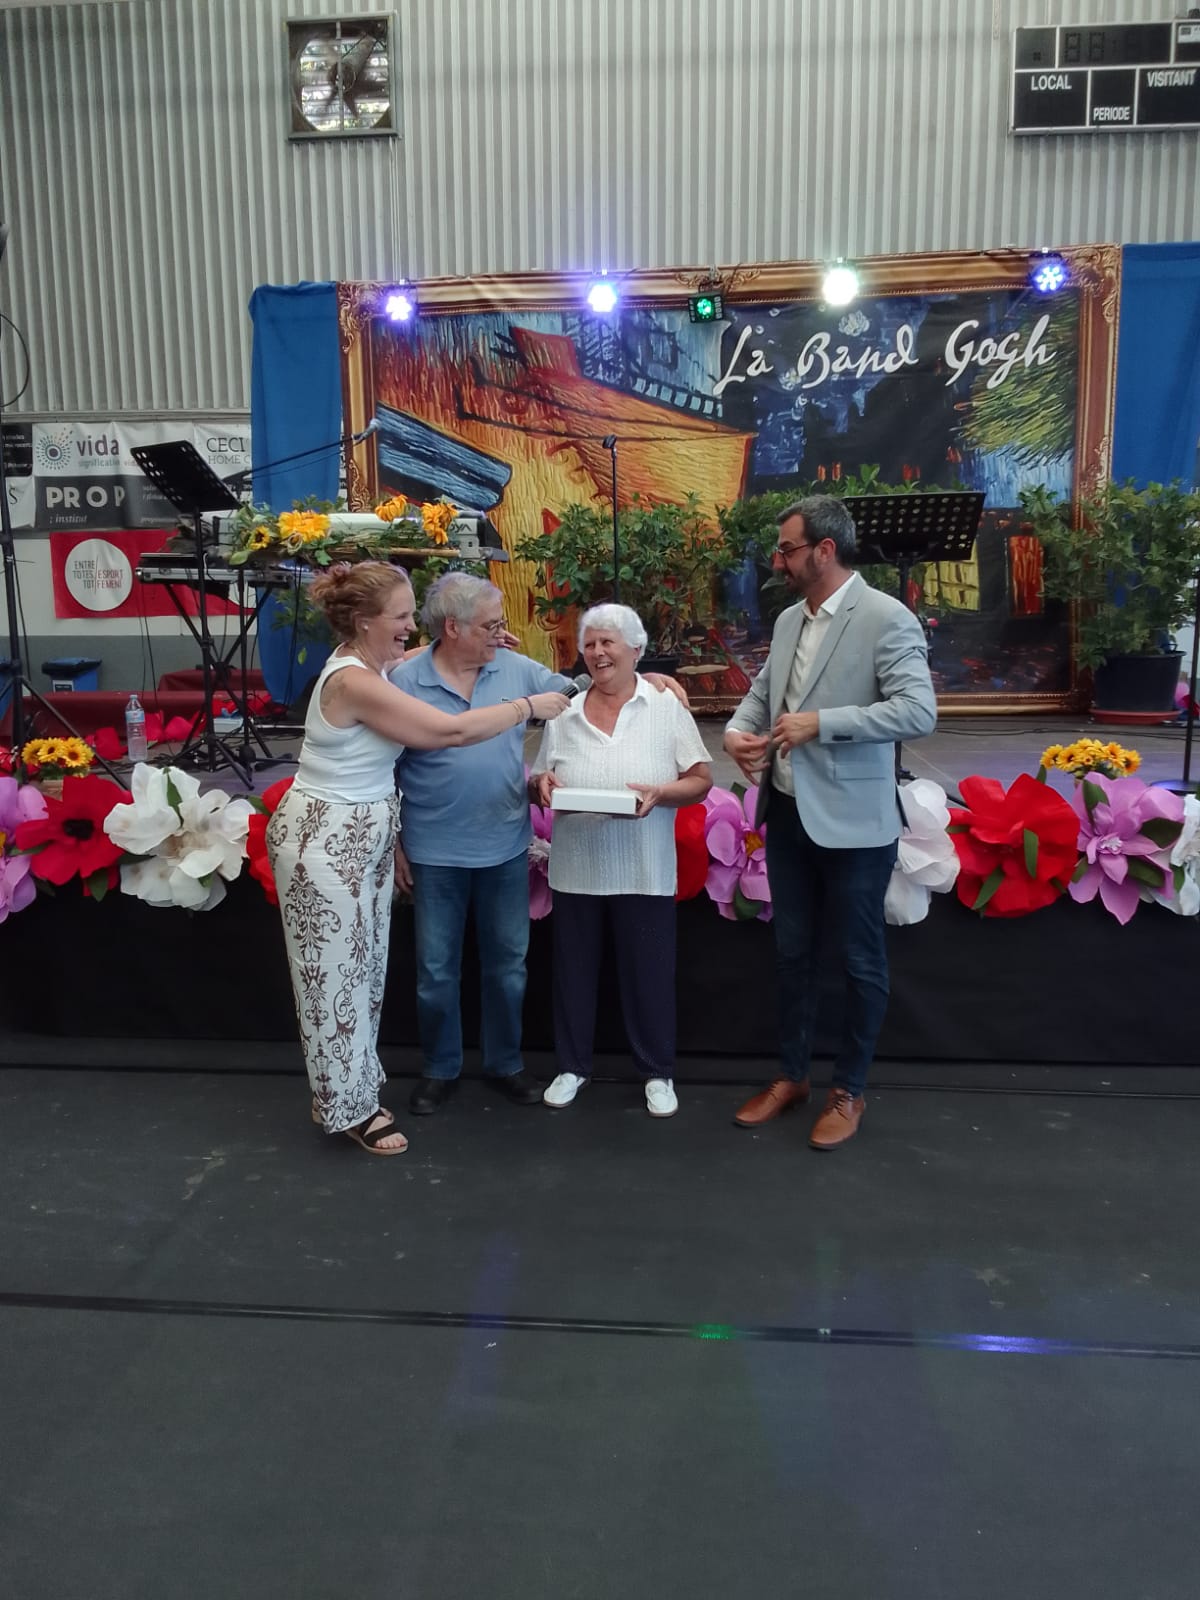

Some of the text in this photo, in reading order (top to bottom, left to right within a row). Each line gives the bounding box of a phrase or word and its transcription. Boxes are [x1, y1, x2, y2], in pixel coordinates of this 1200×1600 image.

[1031, 74, 1072, 91] LOCAL
[1147, 69, 1197, 87] VISITANT
[1093, 106, 1131, 121] PERIODE
[713, 314, 1056, 395] La Band Gogh
[76, 435, 120, 456] vida
[206, 437, 249, 453] CECI
[208, 454, 241, 465] HOME
[73, 560, 96, 570] ENTRE
[97, 568, 123, 579] ESPORT
[83, 579, 94, 589] TOT
